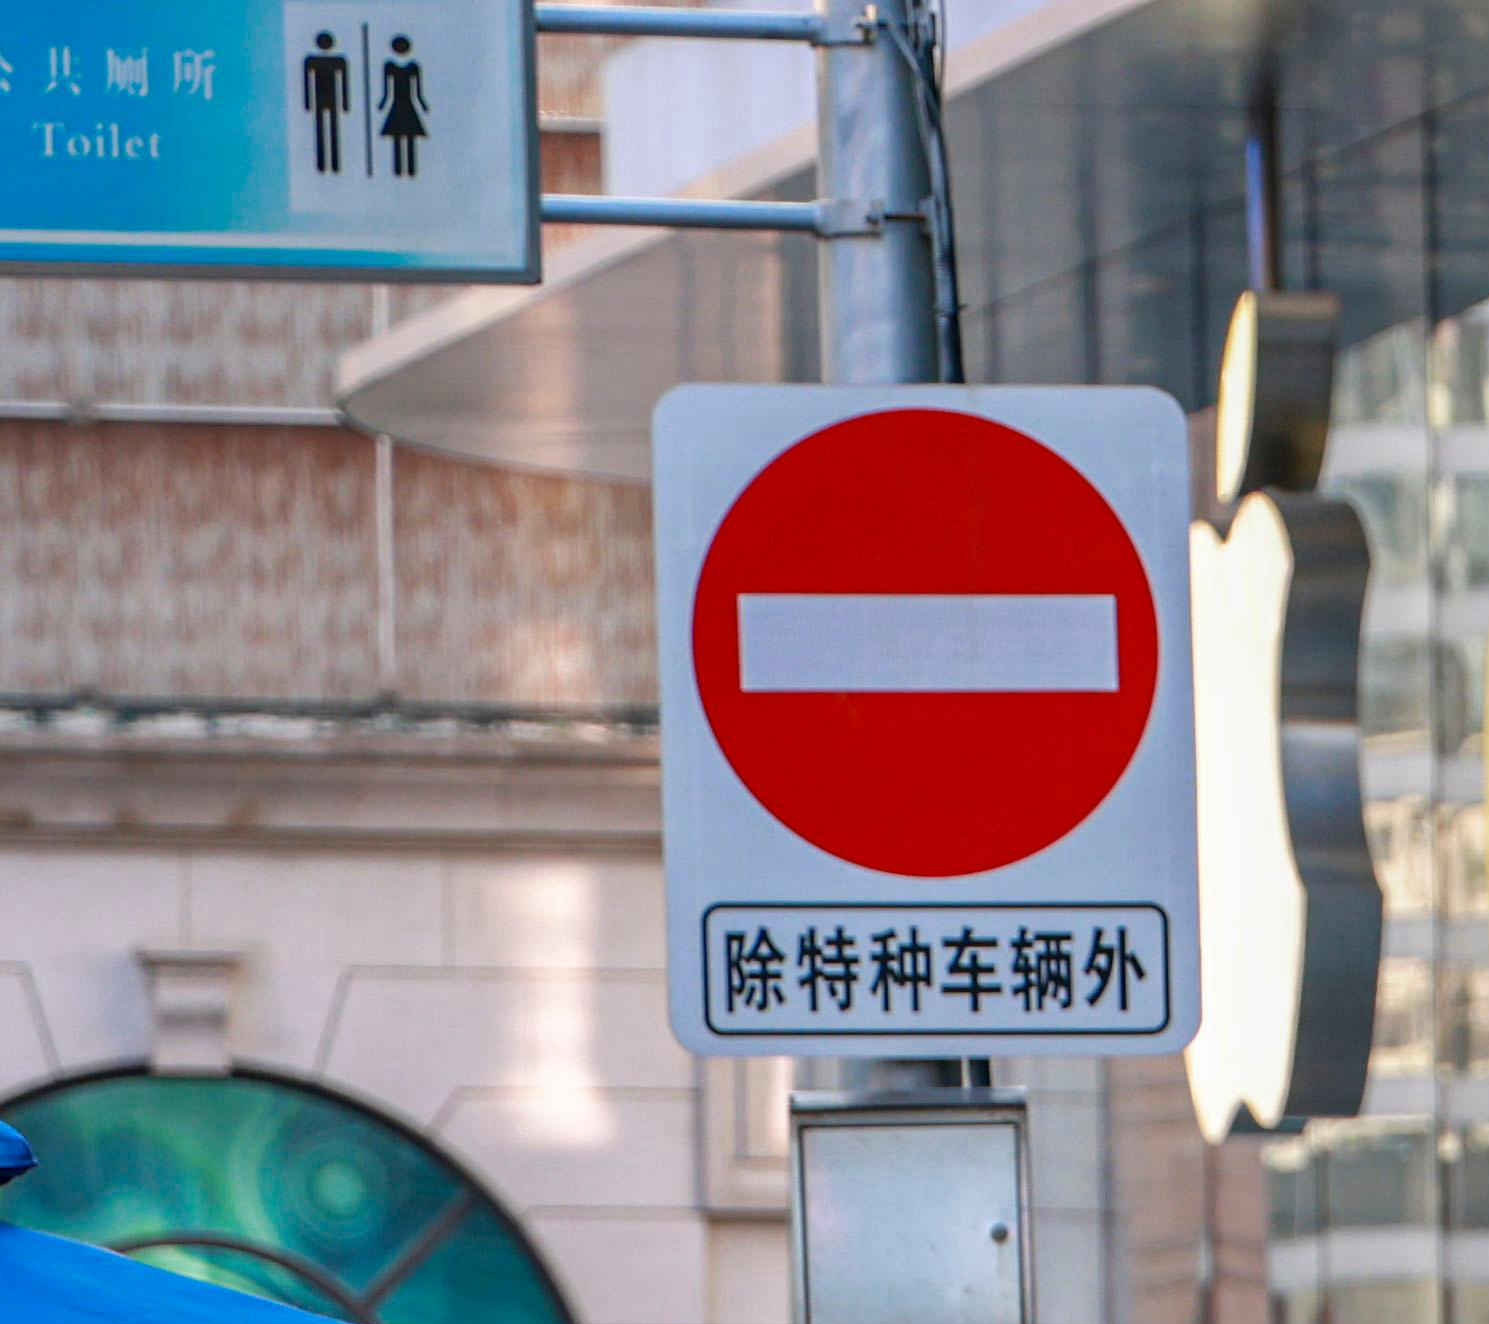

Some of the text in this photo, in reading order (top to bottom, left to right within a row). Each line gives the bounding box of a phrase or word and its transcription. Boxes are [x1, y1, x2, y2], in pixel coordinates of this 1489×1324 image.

[32, 122, 161, 158] Toilet
[724, 926, 1147, 1014] 除特种车辆外
